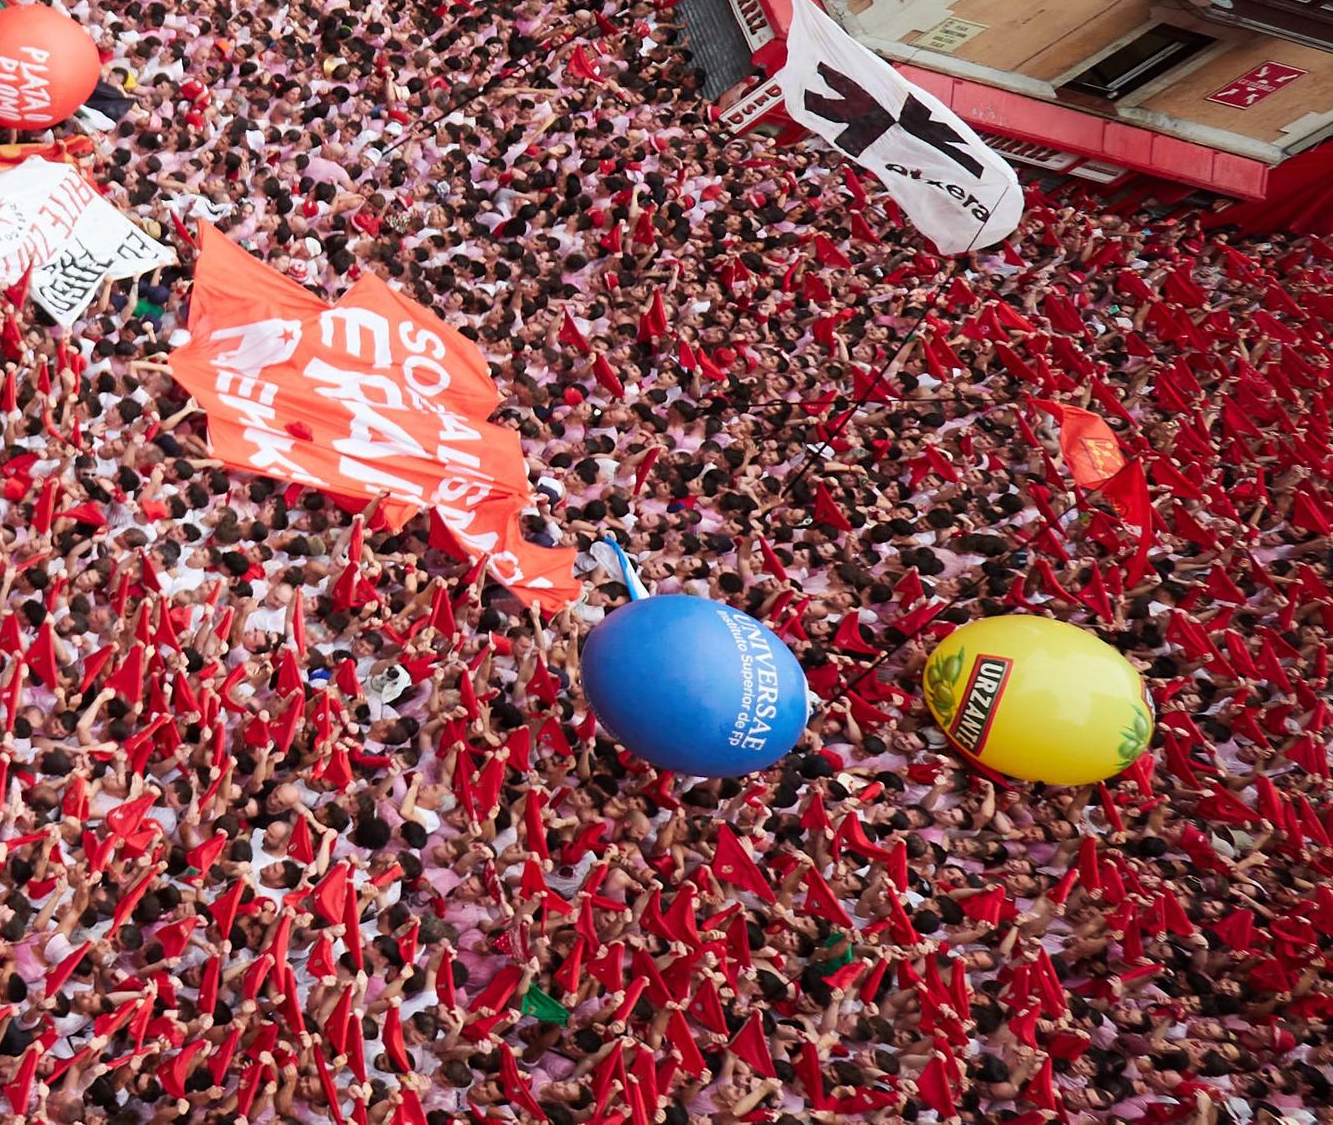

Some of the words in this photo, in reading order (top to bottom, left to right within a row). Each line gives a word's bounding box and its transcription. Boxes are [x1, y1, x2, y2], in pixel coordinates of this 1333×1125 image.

[20, 46, 51, 111] PLATA
[725, 83, 782, 128] DESD
[23, 113, 53, 123] O
[885, 163, 991, 223] etxera
[733, 613, 778, 751] UNIVERSAE
[740, 654, 755, 710] Superior
[955, 662, 1004, 749] URZANTE
[734, 712, 751, 729] de
